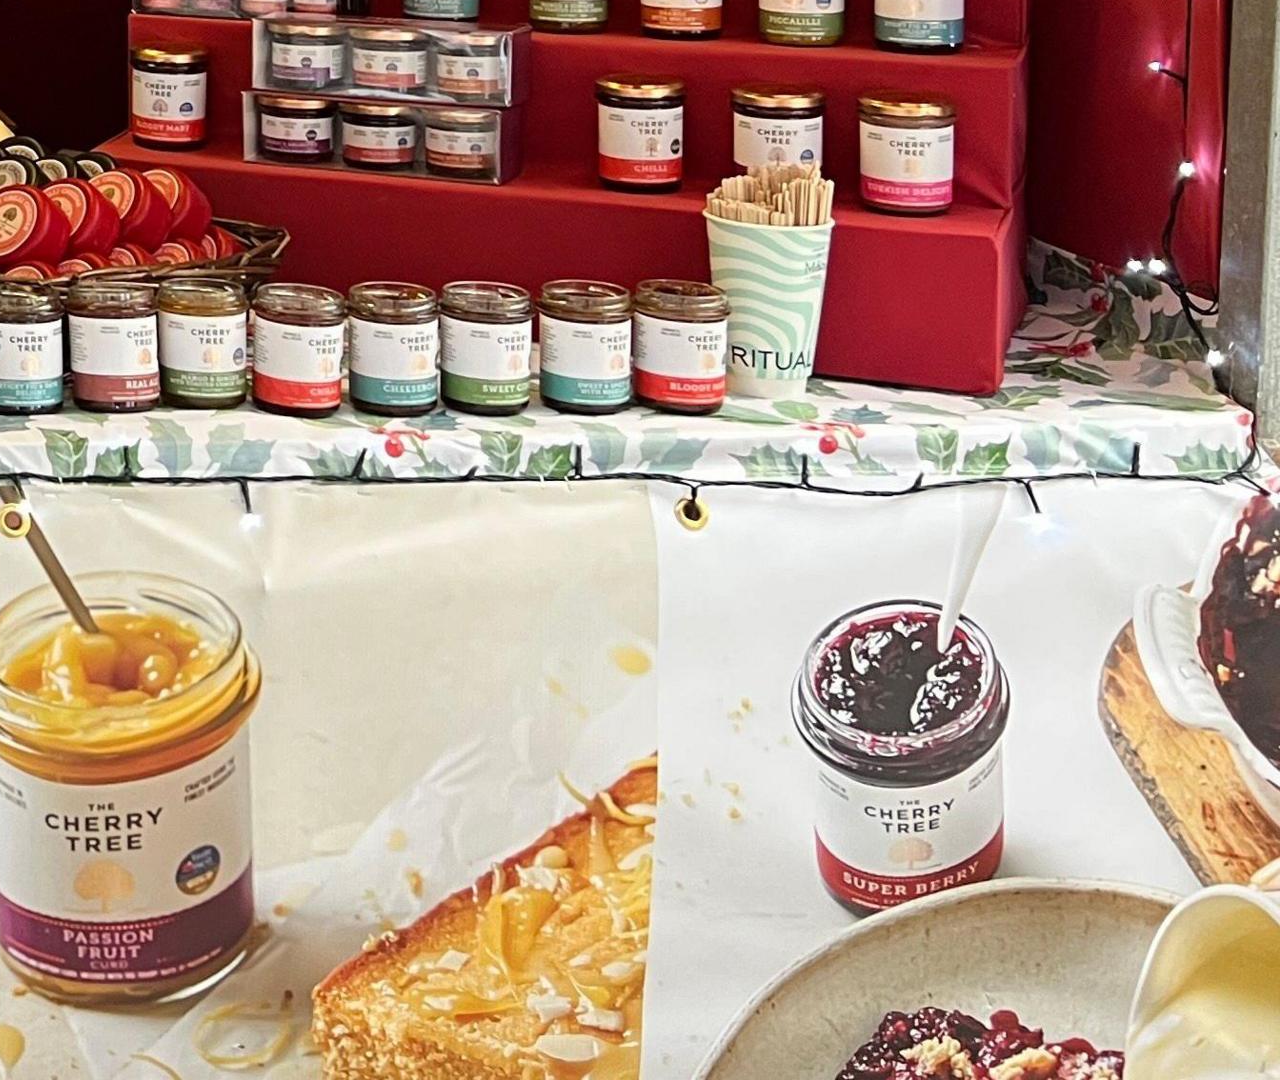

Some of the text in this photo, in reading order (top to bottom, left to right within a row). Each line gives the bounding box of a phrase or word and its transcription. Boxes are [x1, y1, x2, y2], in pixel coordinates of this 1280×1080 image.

[768, 16, 822, 26] PICCALILLI
[633, 164, 668, 174] CHILLI
[190, 328, 231, 338] CHERRY
[199, 336, 225, 346] TREE
[125, 379, 148, 389] REAL
[482, 383, 514, 393] SWEET
[669, 382, 703, 392] BLOODY
[88, 802, 115, 812] THE
[864, 798, 955, 821] CHERRY
[44, 807, 164, 832] CHERRY
[881, 818, 940, 834] TREE
[66, 834, 143, 852] TREE
[842, 861, 979, 895] SUPER BERRY
[63, 928, 154, 945] PASSION
[77, 945, 141, 960] FRUIT
[90, 960, 129, 970] CURD
